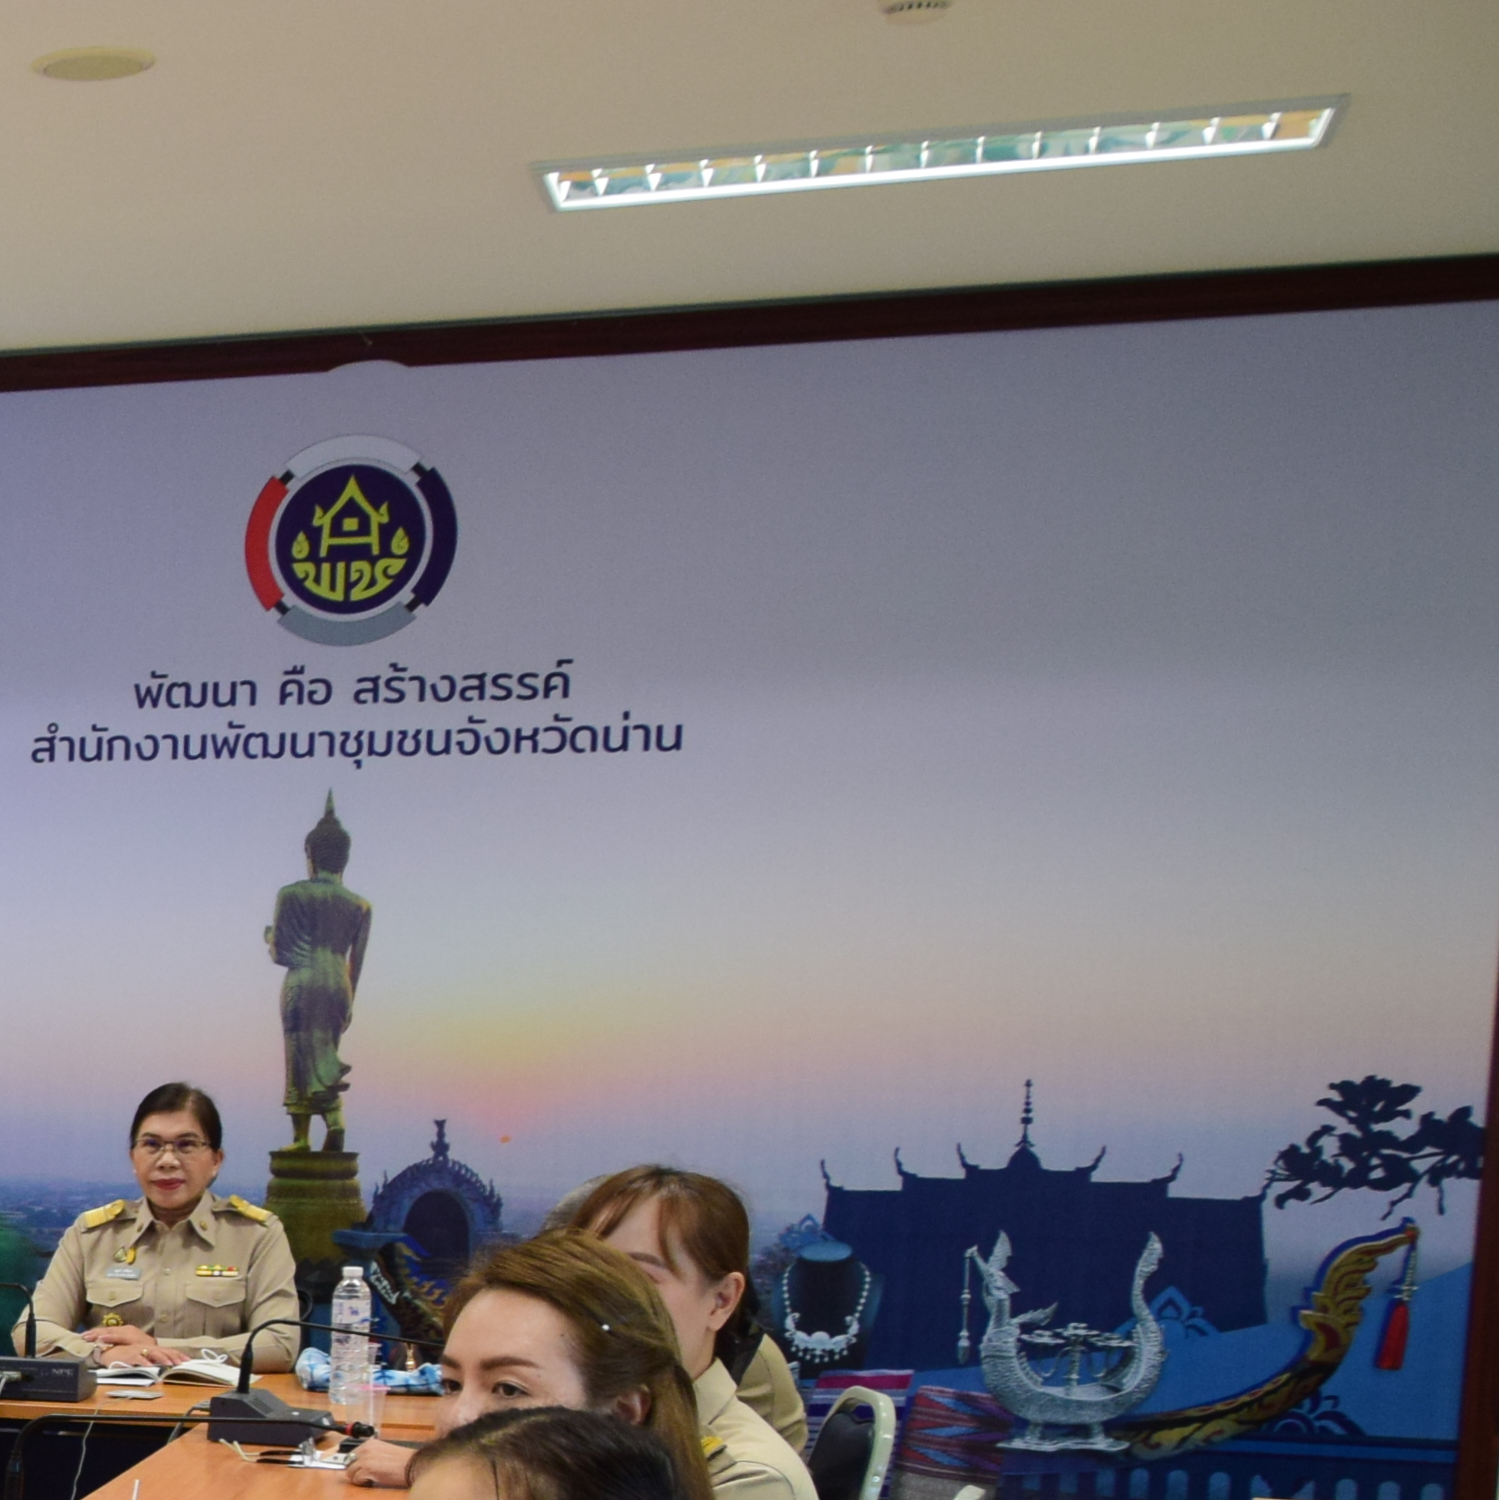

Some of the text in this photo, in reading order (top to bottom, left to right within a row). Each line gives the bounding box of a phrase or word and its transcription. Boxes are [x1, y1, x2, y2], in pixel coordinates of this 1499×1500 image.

[133, 658, 575, 710] พัฒนา คือ สร้างสรรค์
[30, 710, 684, 771] สำนักงานพัฒนาชุมชนจังหวัดน่าน
